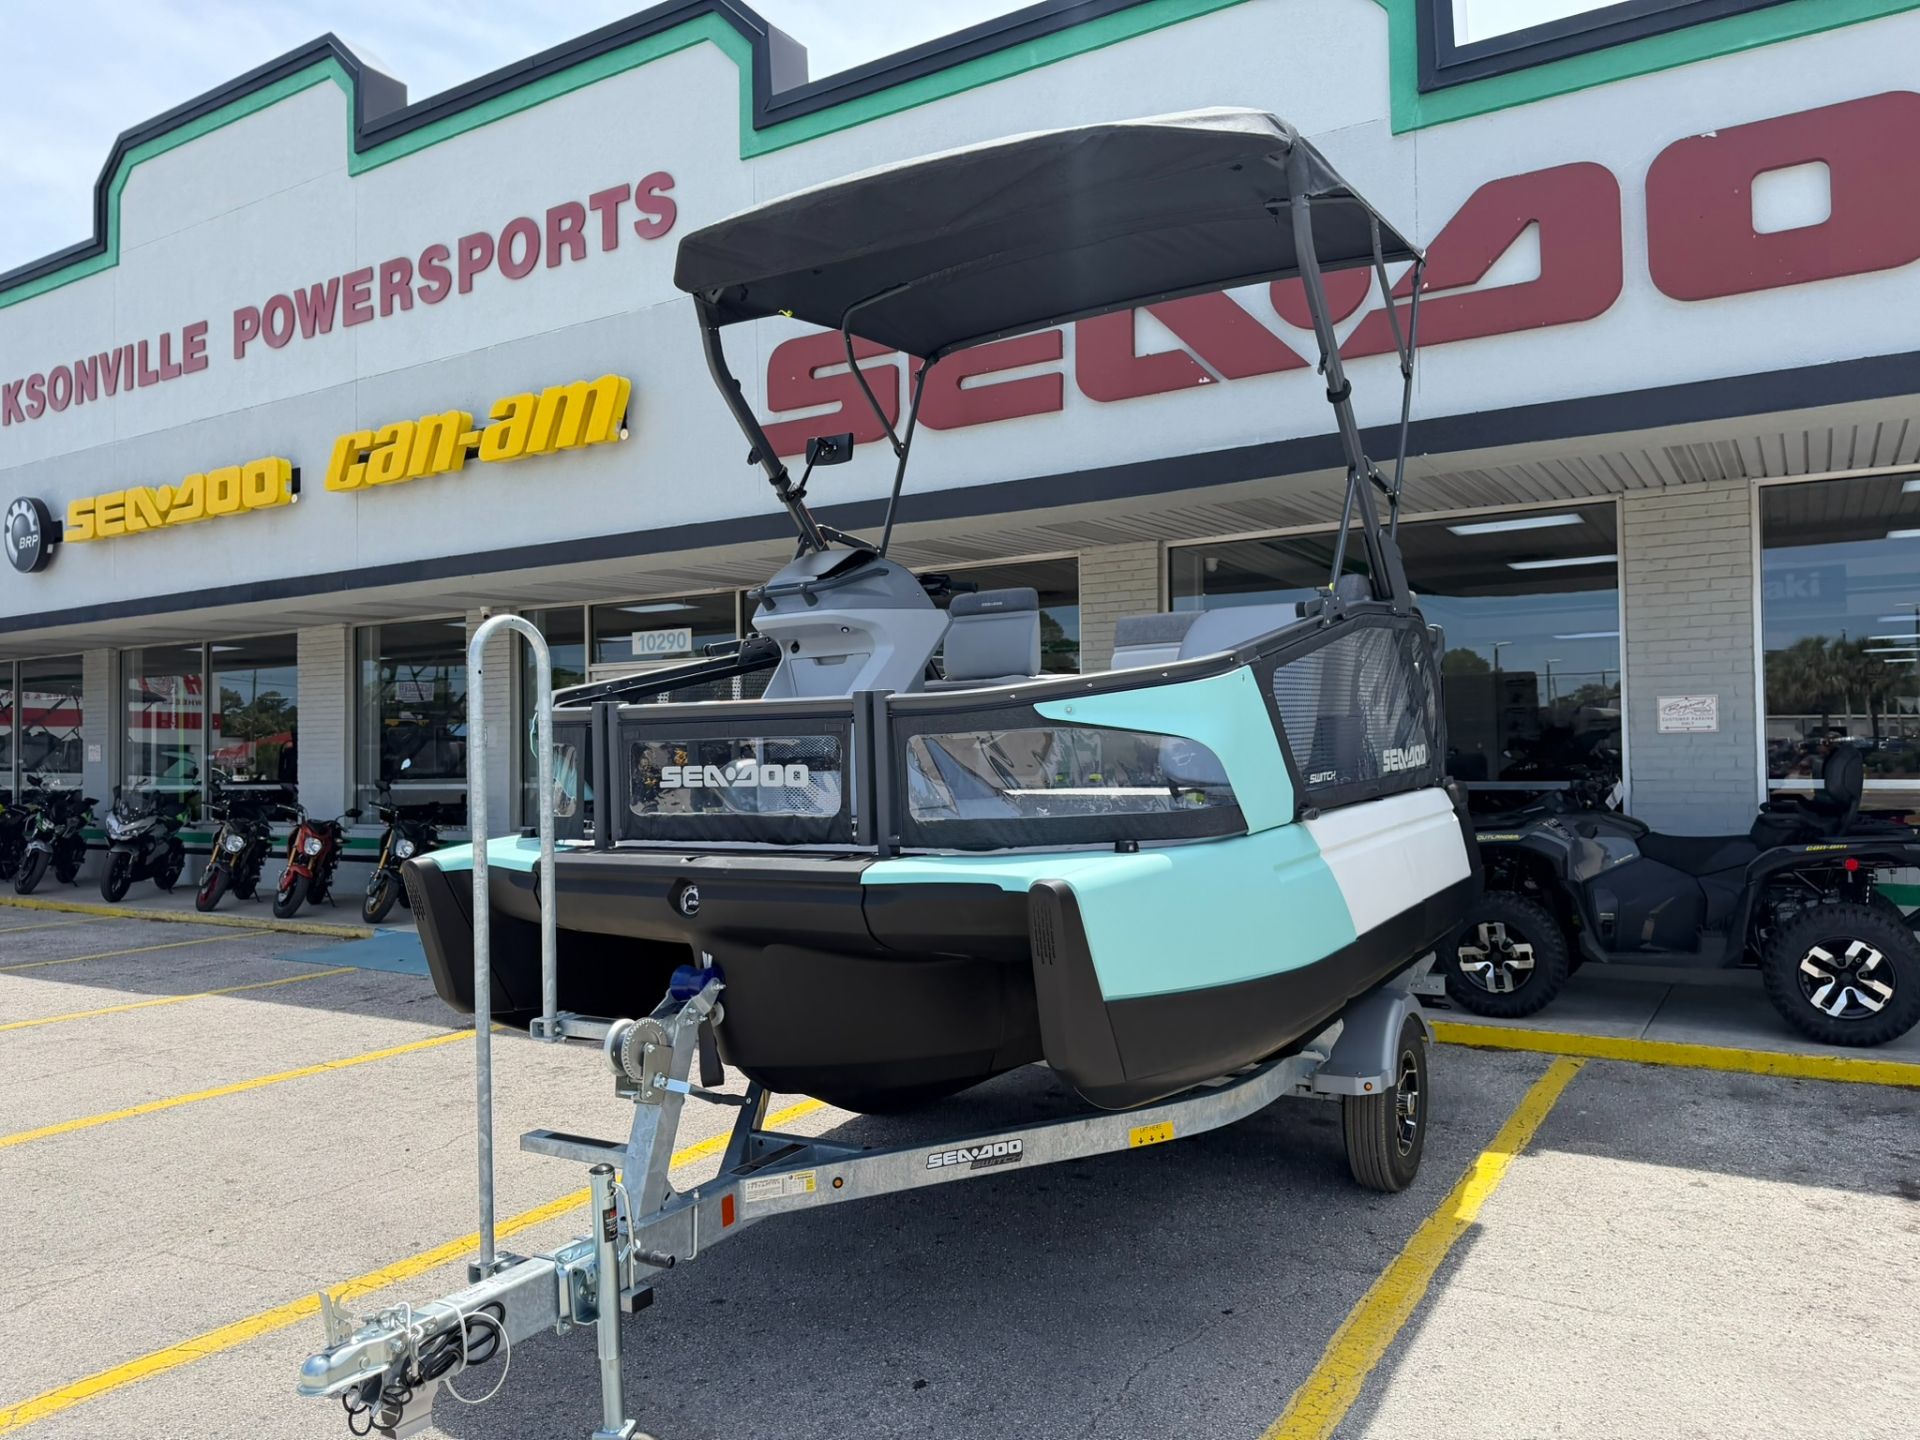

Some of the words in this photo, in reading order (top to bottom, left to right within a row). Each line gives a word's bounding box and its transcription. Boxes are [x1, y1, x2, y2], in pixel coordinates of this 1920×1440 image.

[1, 320, 209, 427] KSONVILLE
[233, 171, 677, 360] POWERSPORTS
[19, 534, 39, 550] BRP
[639, 631, 687, 652] 10290
[1309, 770, 1337, 784] SWITCH
